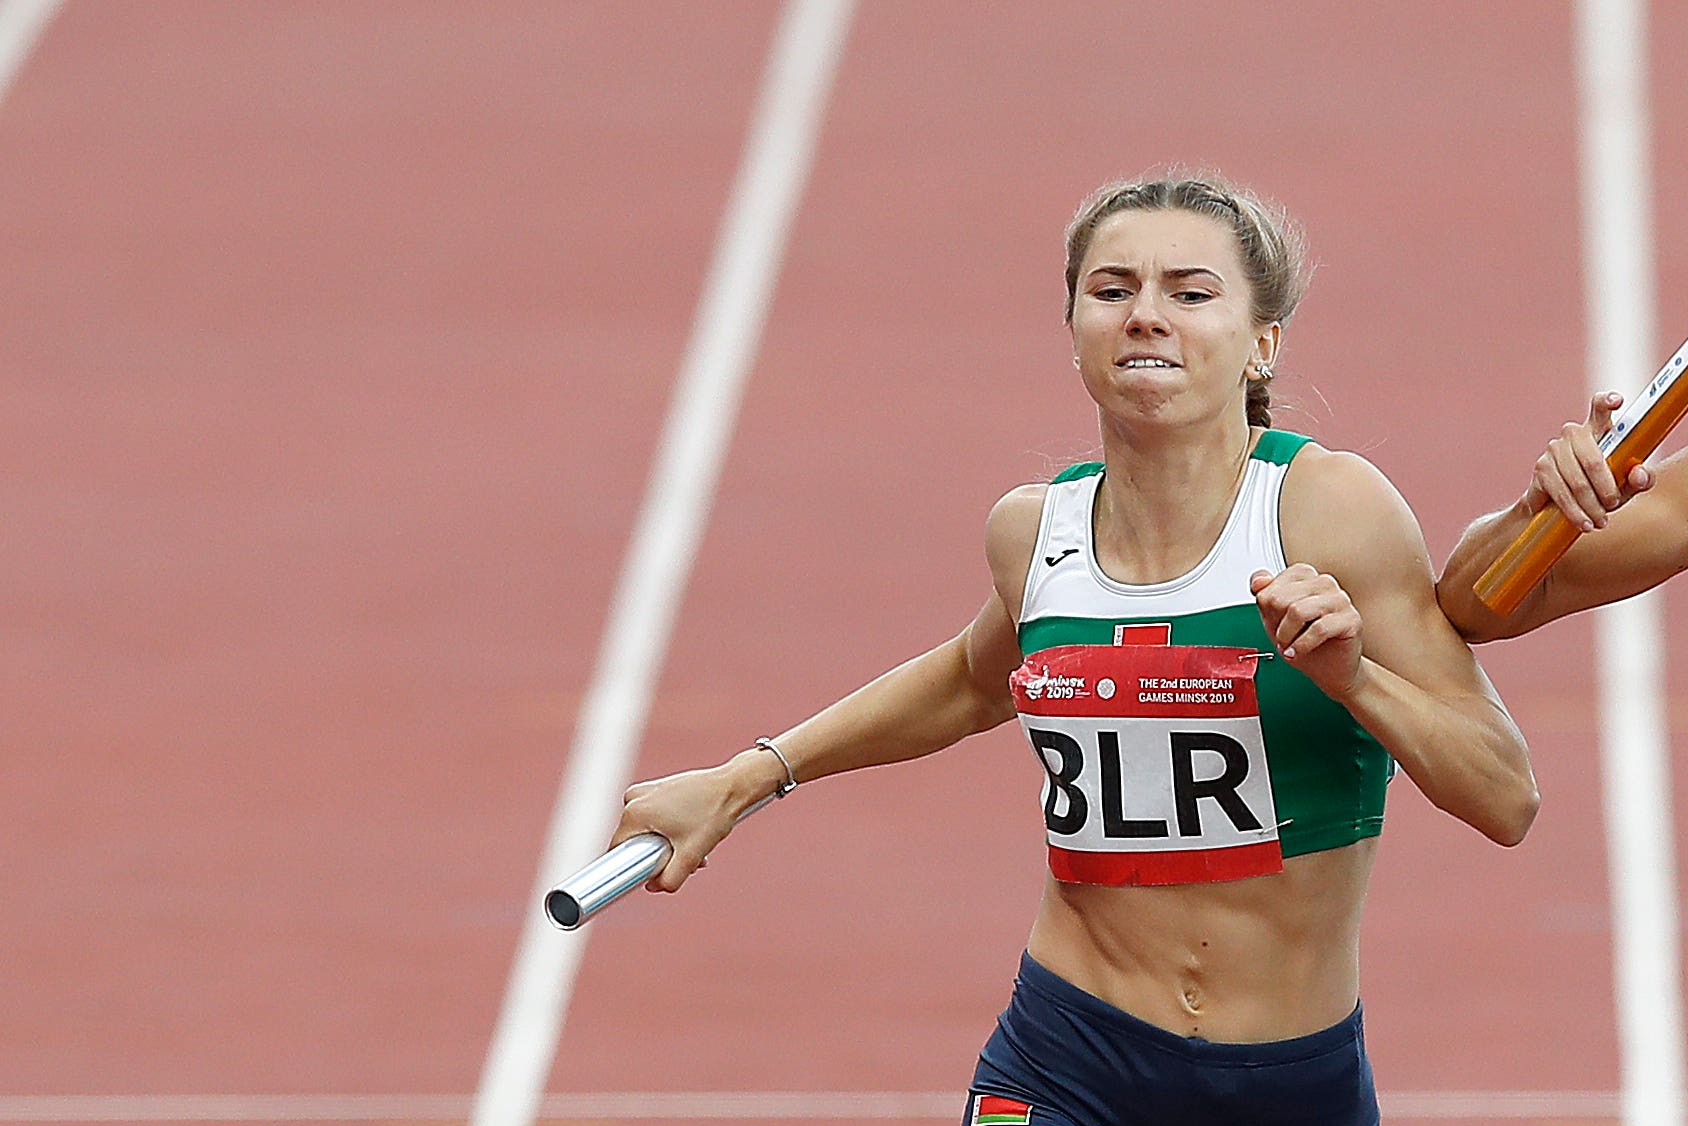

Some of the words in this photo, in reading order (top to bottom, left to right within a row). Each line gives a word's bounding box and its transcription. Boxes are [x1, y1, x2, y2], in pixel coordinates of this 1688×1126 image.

[1138, 678, 1159, 689] THE
[1160, 678, 1178, 689] 2nd
[1180, 678, 1233, 690] EUROPEAN
[1046, 686, 1074, 699] 2019
[1138, 692, 1174, 703] GAMES
[1175, 692, 1208, 703] MINSK
[1209, 693, 1235, 703] 2019
[1029, 728, 1264, 839] BLR
